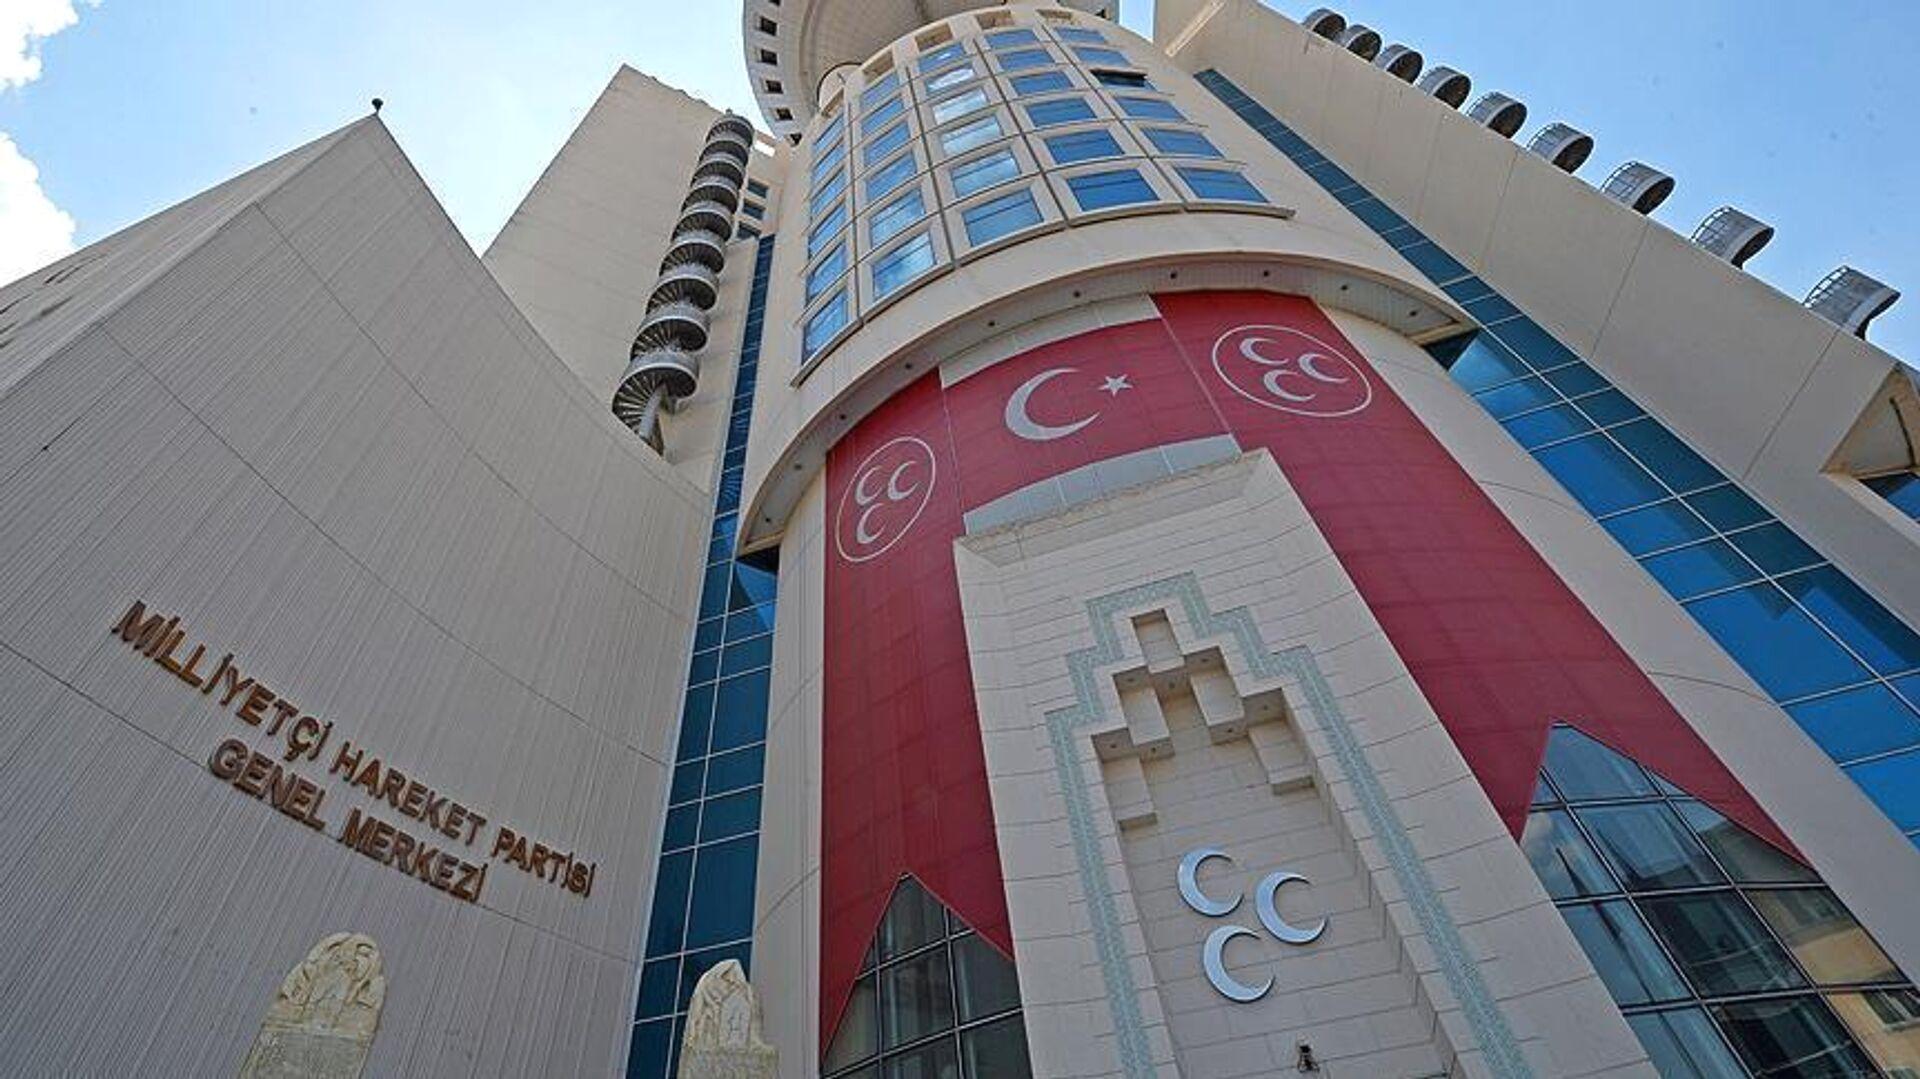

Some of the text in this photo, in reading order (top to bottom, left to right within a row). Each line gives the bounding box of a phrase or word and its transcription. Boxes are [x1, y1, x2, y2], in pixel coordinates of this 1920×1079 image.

[111, 600, 597, 898] MİLLİYETÇİ HAREKET PARTİSİ
[208, 739, 488, 901] GENEL MERKEZİ
